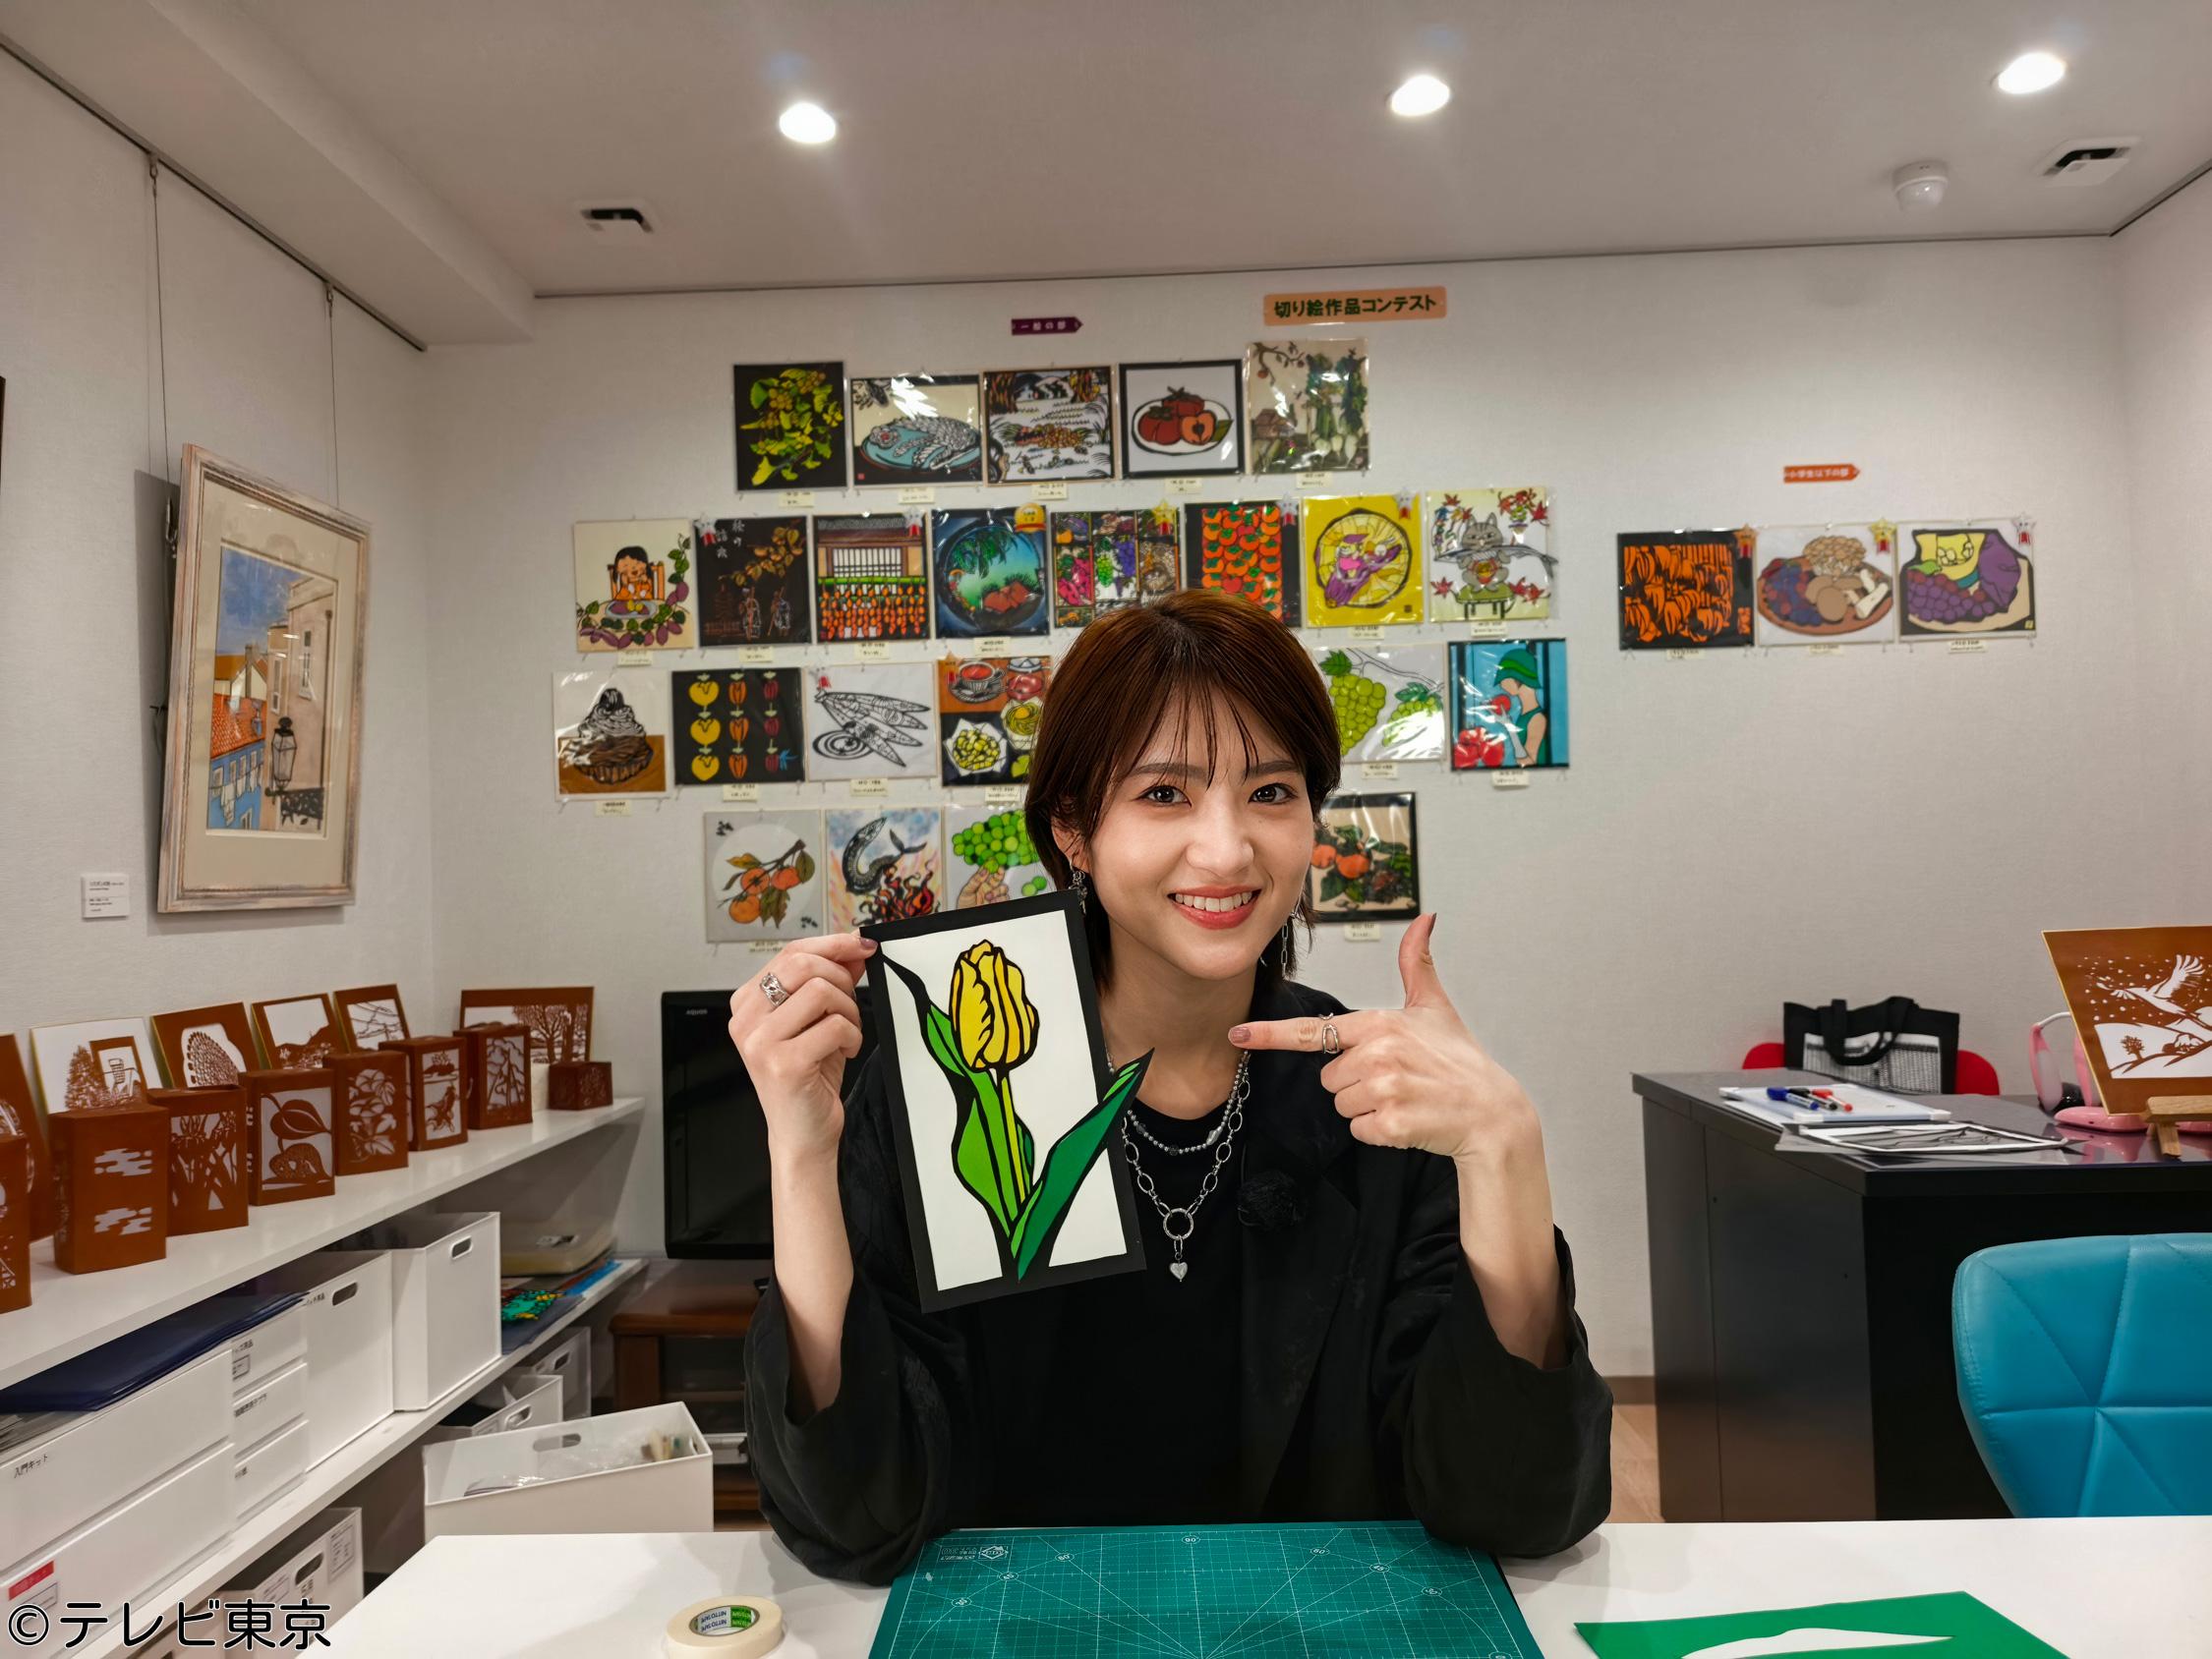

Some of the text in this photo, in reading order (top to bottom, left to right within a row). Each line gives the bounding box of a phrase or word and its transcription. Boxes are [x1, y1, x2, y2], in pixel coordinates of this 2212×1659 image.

[1274, 295, 1436, 318] 切り絵作品コンテスト
[711, 1619, 728, 1628] NITTO
